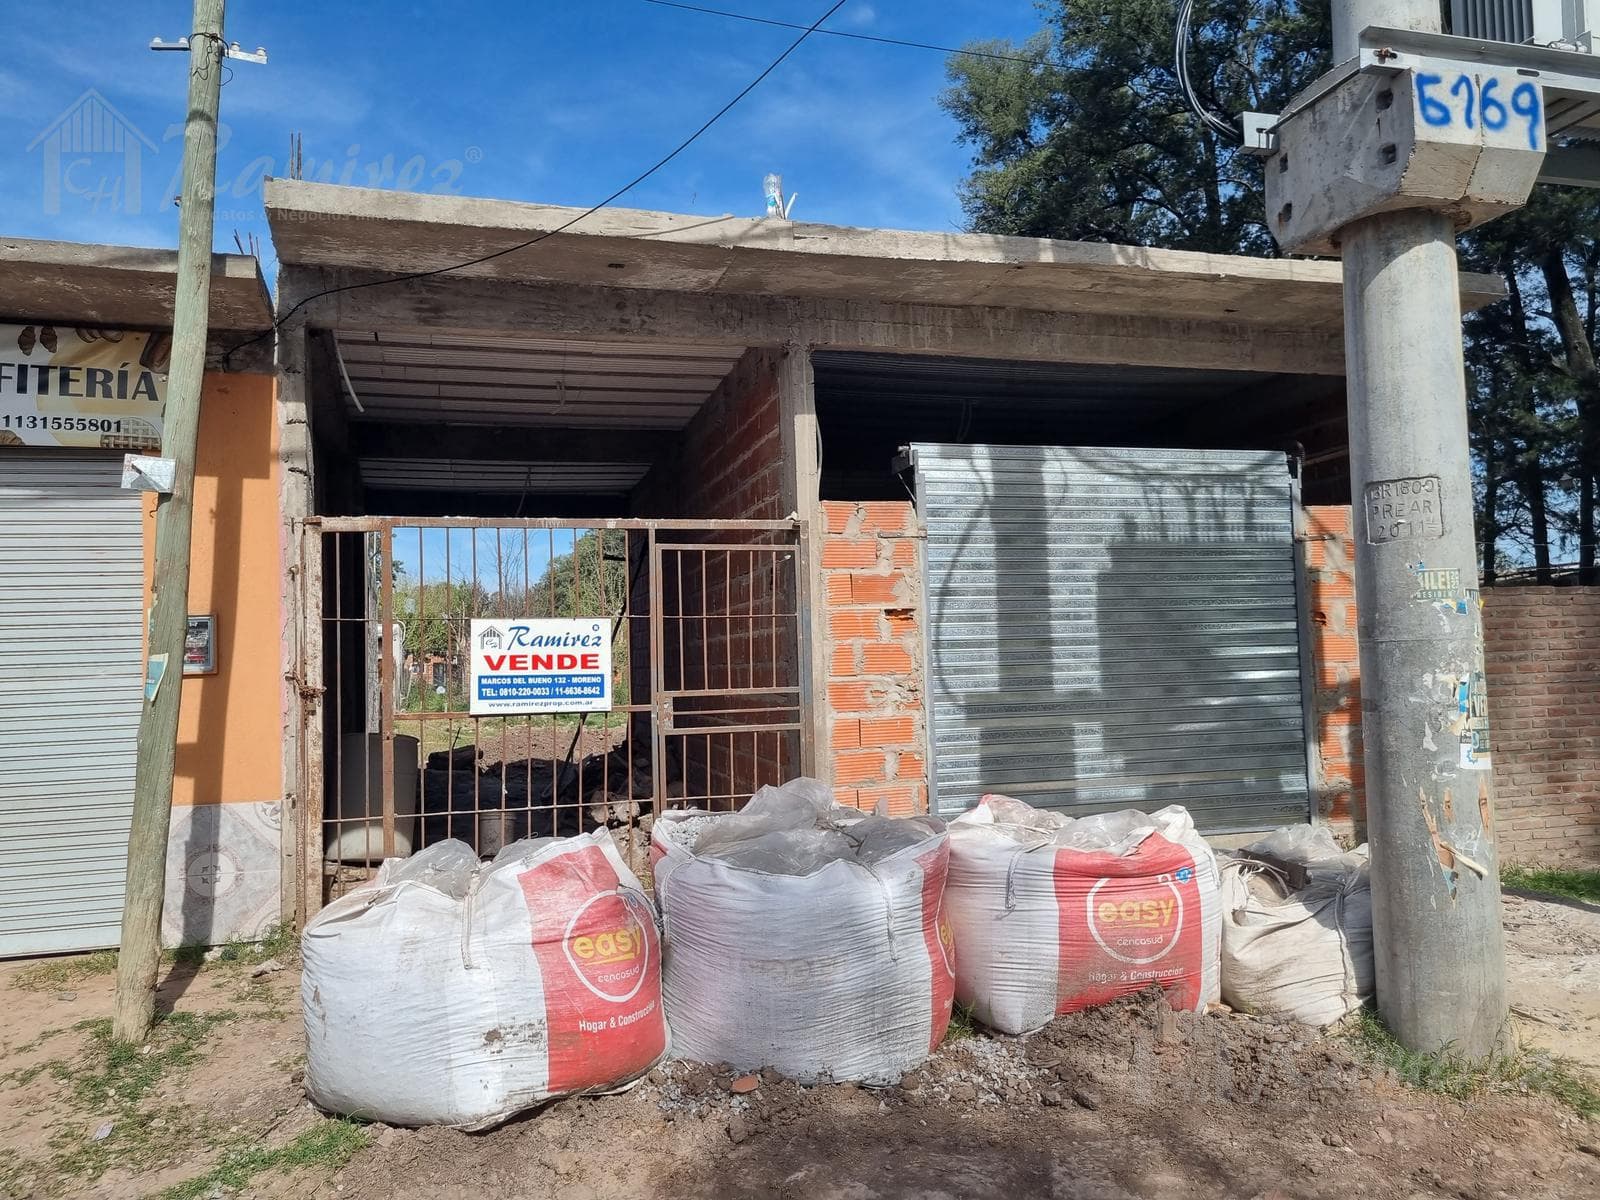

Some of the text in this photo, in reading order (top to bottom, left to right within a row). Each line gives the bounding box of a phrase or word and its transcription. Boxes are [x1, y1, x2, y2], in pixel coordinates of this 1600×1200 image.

[1, 414, 122, 433] 1131555801
[507, 625, 602, 651] Ramirez
[483, 653, 600, 671] VENDE
[482, 688, 498, 697] TEL:
[488, 700, 593, 708] www.ramirezprop.com.ar
[1097, 898, 1176, 927] easy
[572, 926, 642, 959] easy
[1116, 935, 1164, 947] cencosud
[578, 1020, 608, 1032] Hogar
[609, 1016, 617, 1028] &
